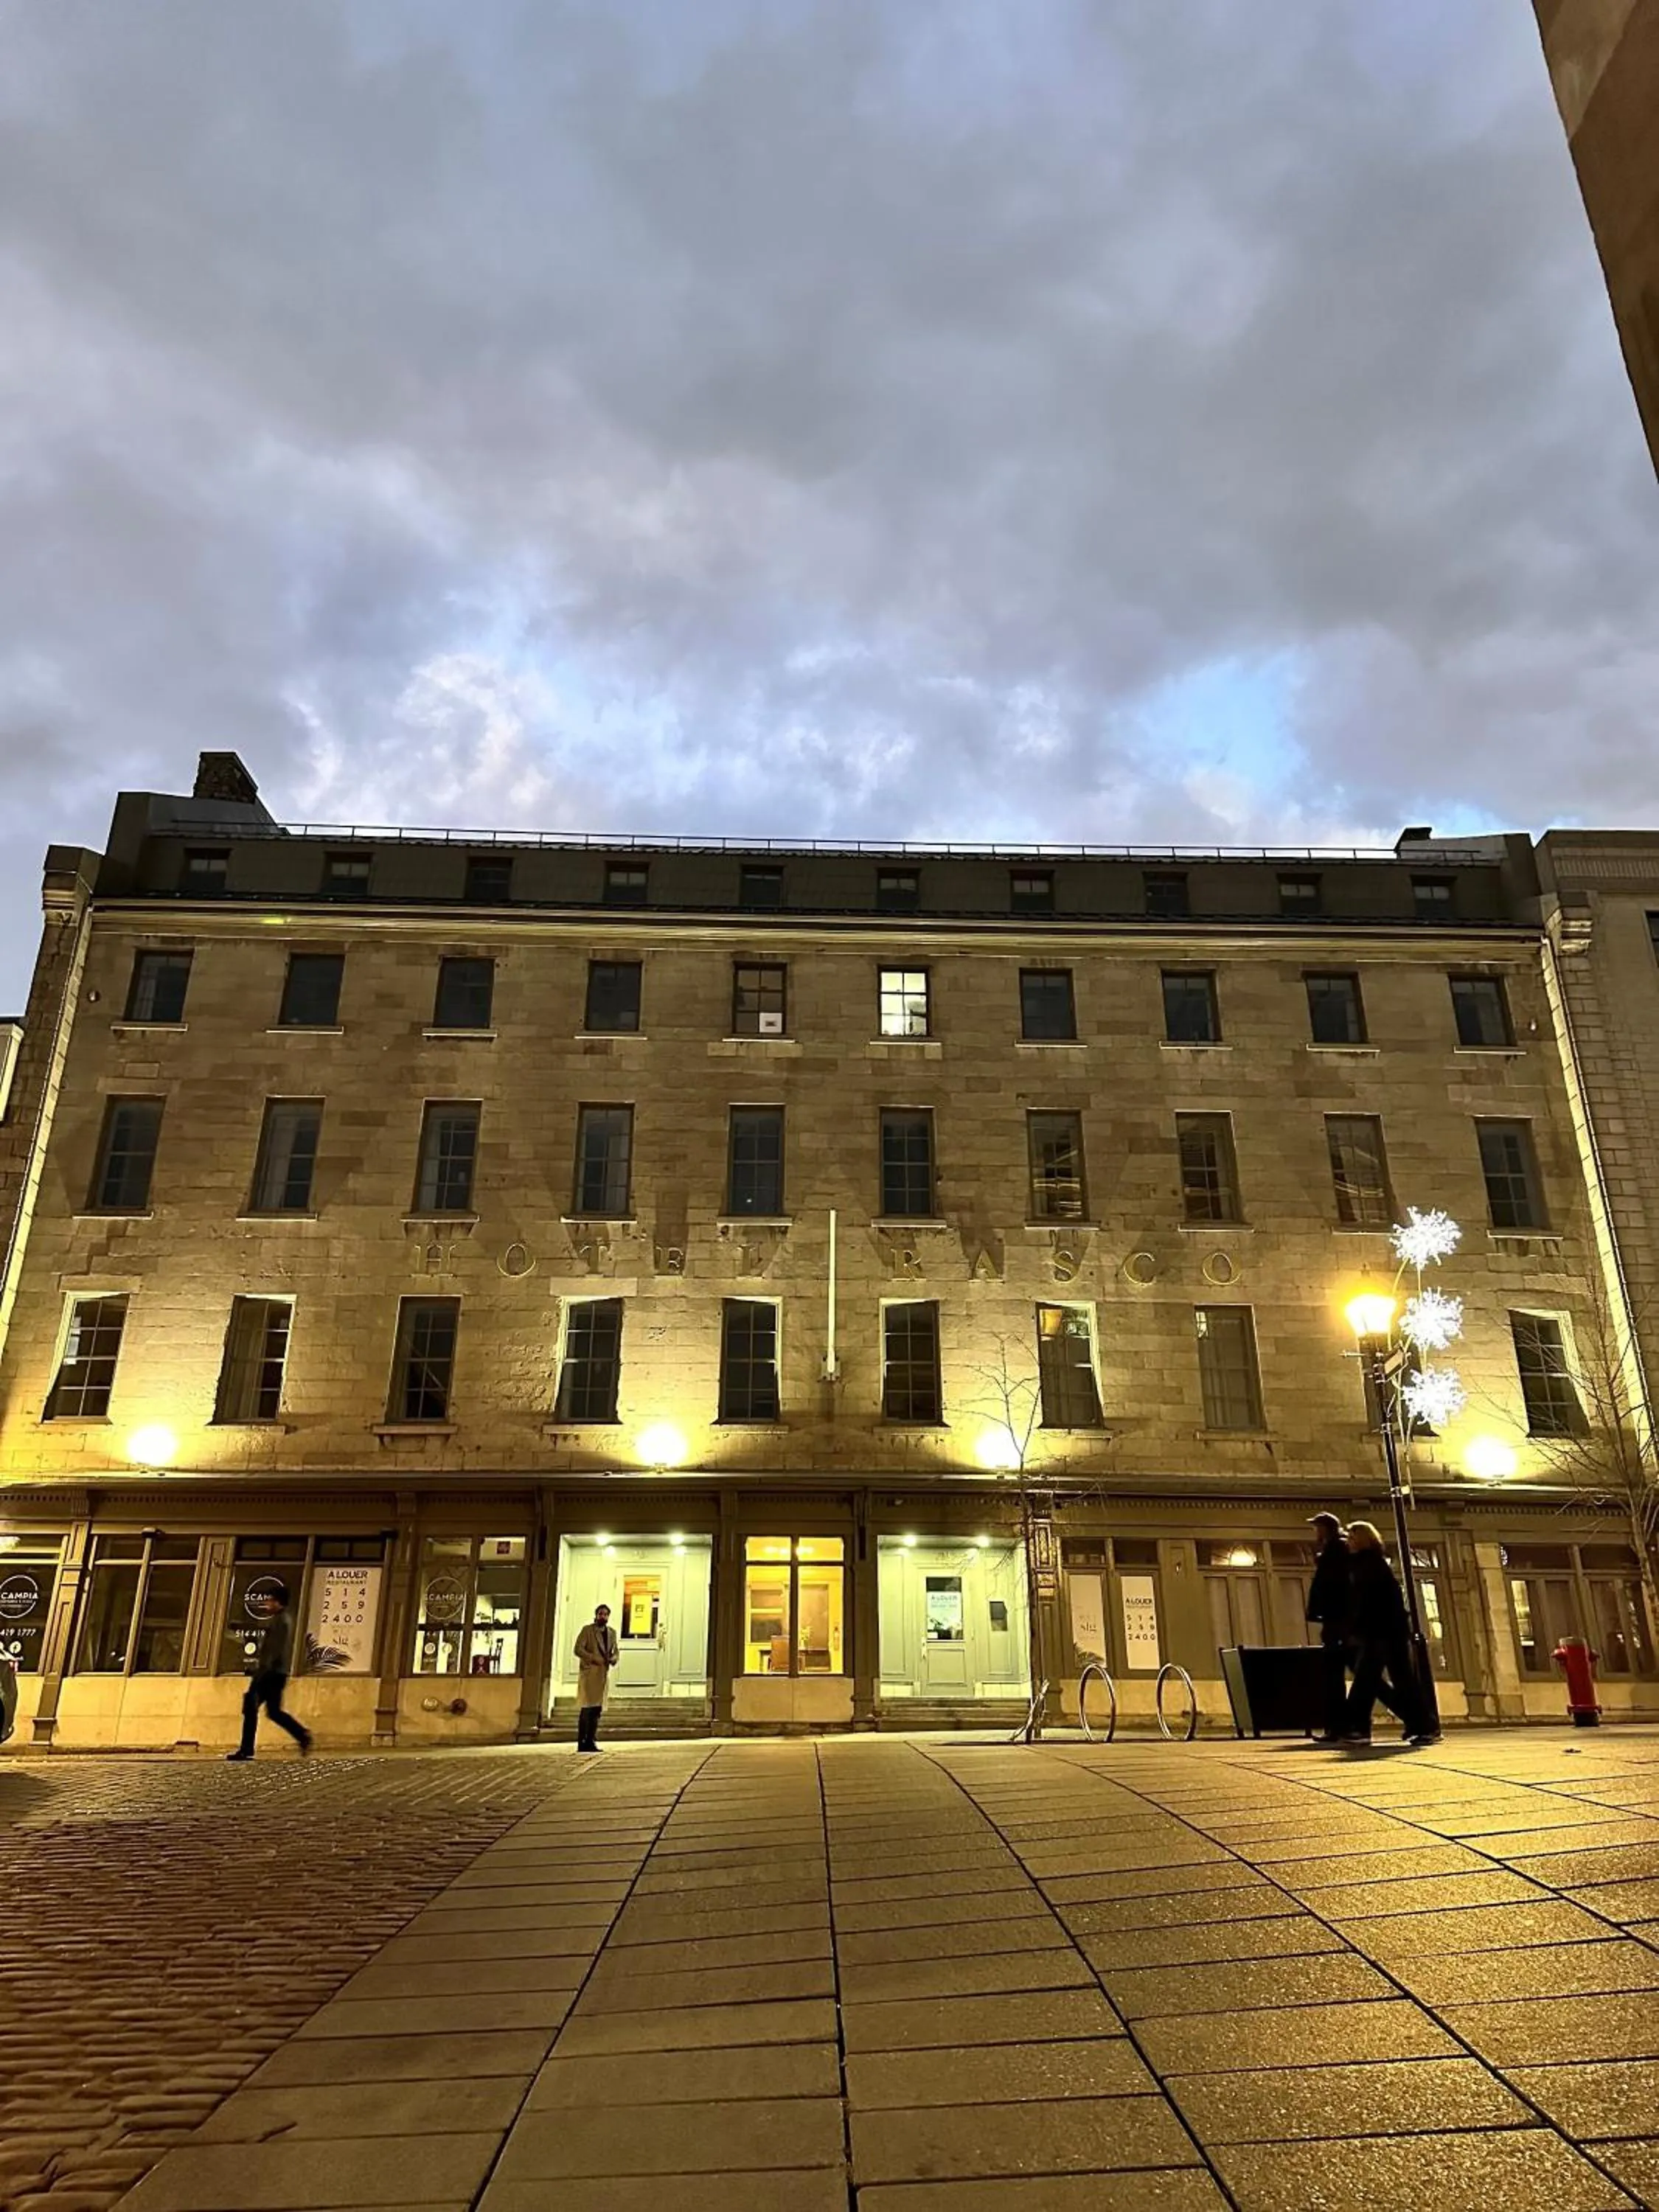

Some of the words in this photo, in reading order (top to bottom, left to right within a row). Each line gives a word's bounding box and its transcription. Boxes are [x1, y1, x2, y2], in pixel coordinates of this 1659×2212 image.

[410, 1243, 768, 1279] HOTEL
[891, 1248, 1242, 1285] RASCO
[327, 1571, 335, 1579] A
[336, 1571, 369, 1579] LOUER
[17, 1628, 36, 1636] 1777
